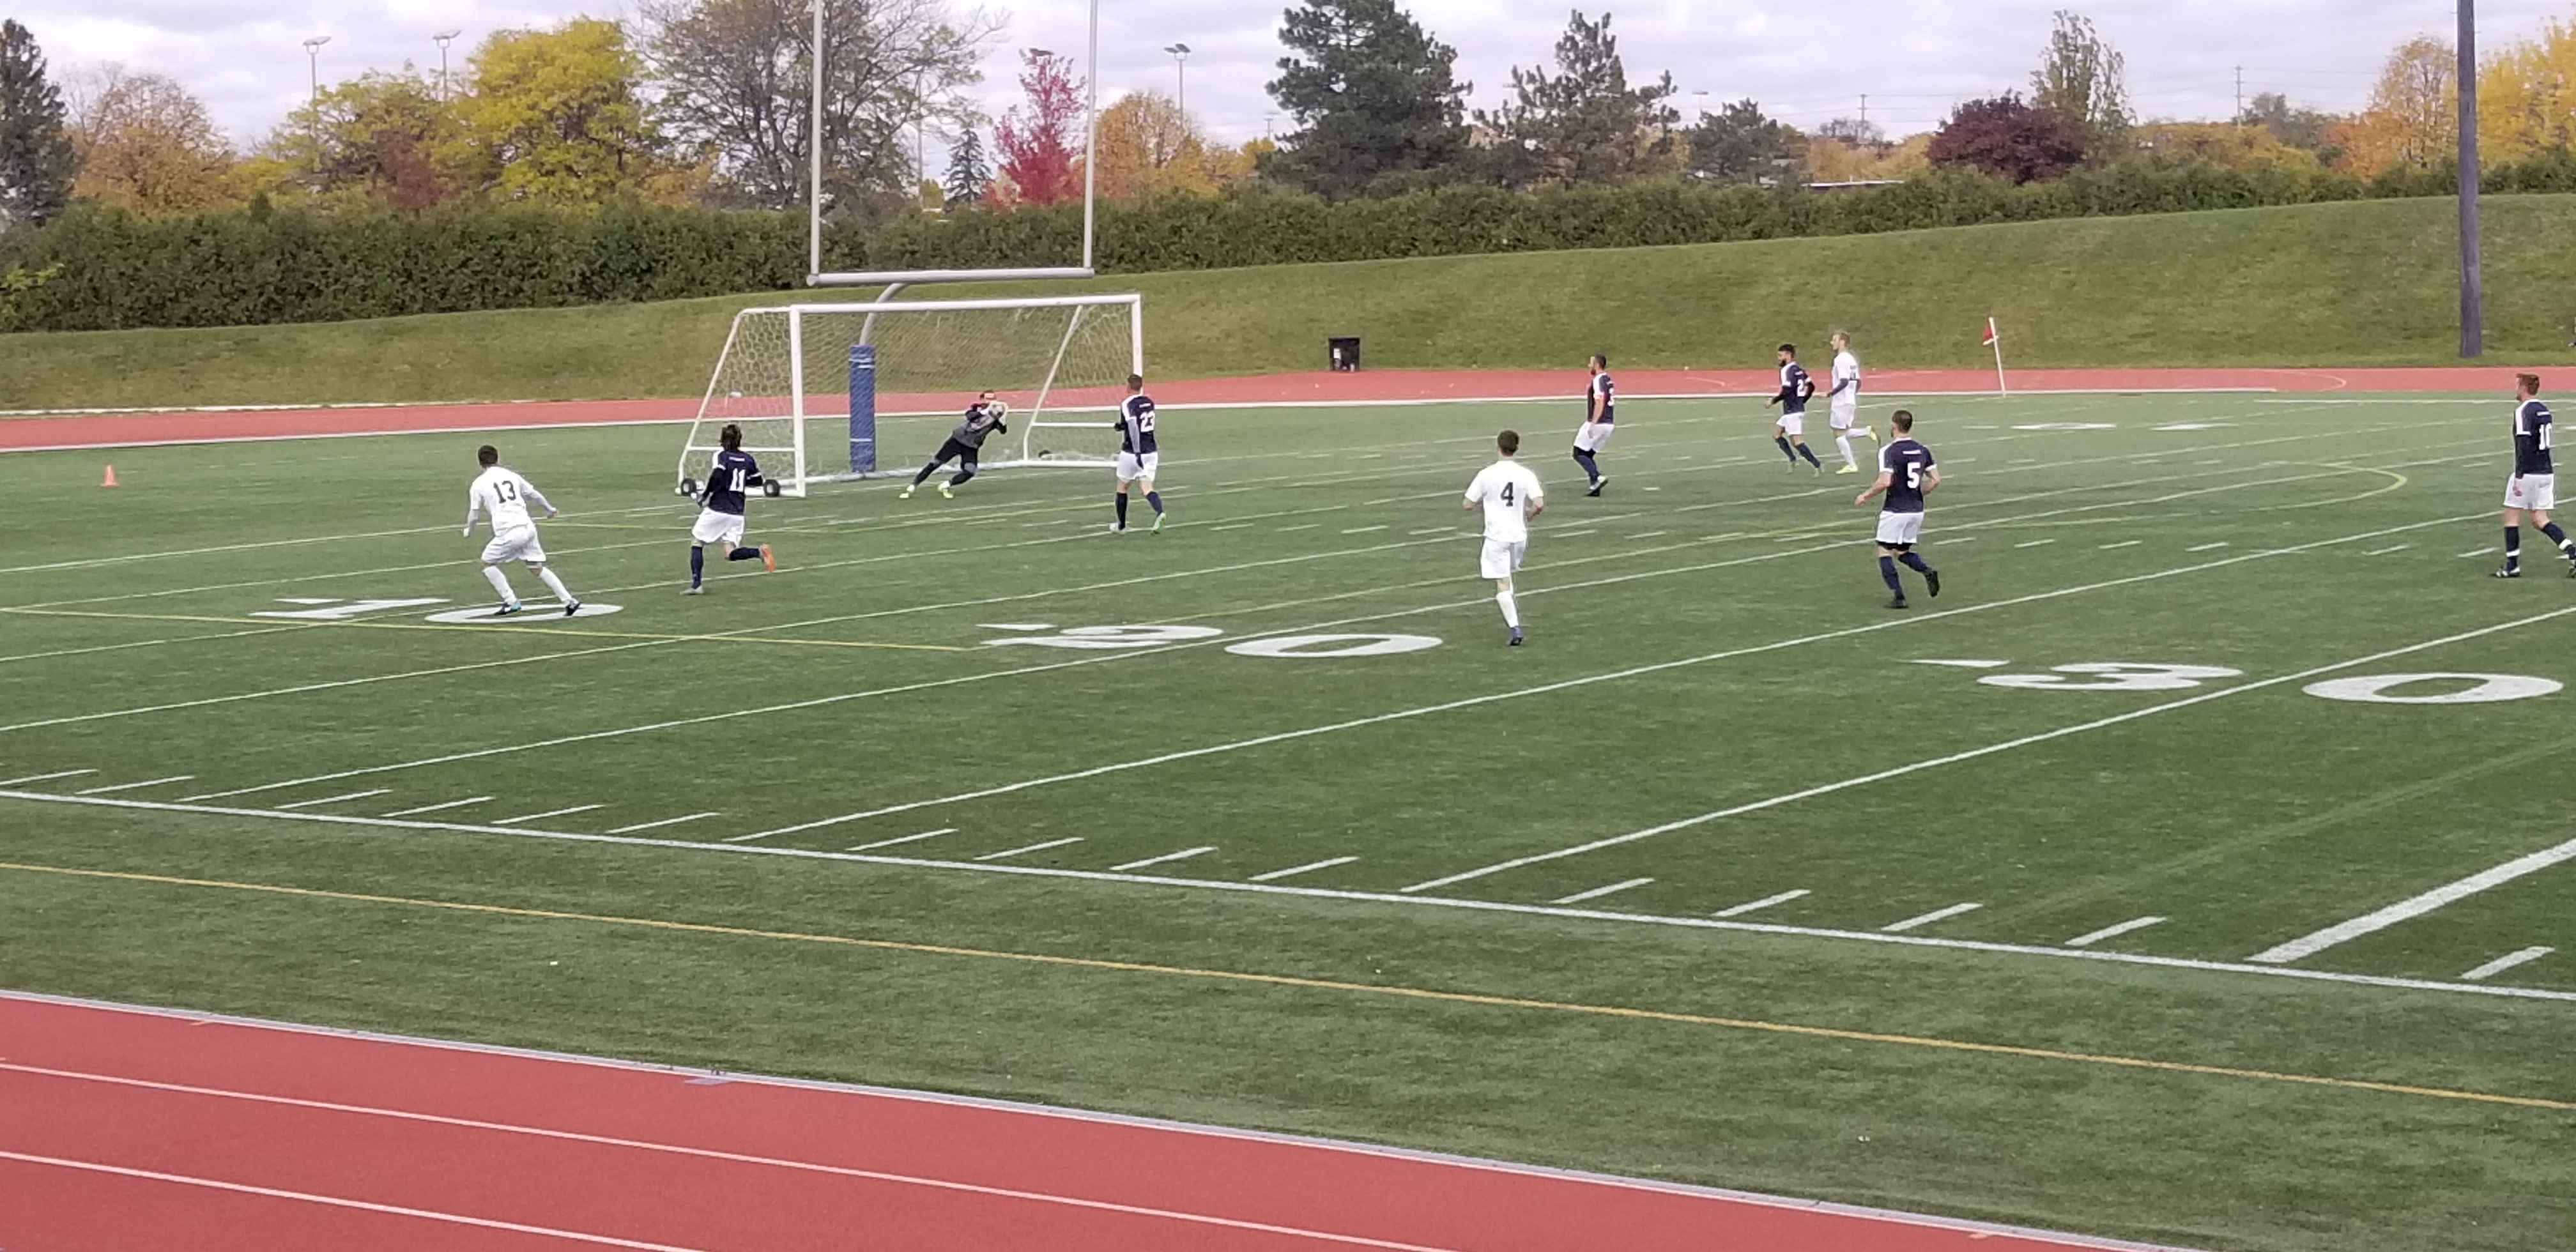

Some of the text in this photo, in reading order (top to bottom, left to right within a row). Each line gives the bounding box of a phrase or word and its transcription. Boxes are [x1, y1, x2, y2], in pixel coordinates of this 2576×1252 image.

[729, 468, 746, 492] 11
[1907, 462, 1921, 489] 5
[493, 480, 517, 504] 13
[1500, 482, 1514, 507] 4
[1977, 662, 2564, 703] 30
